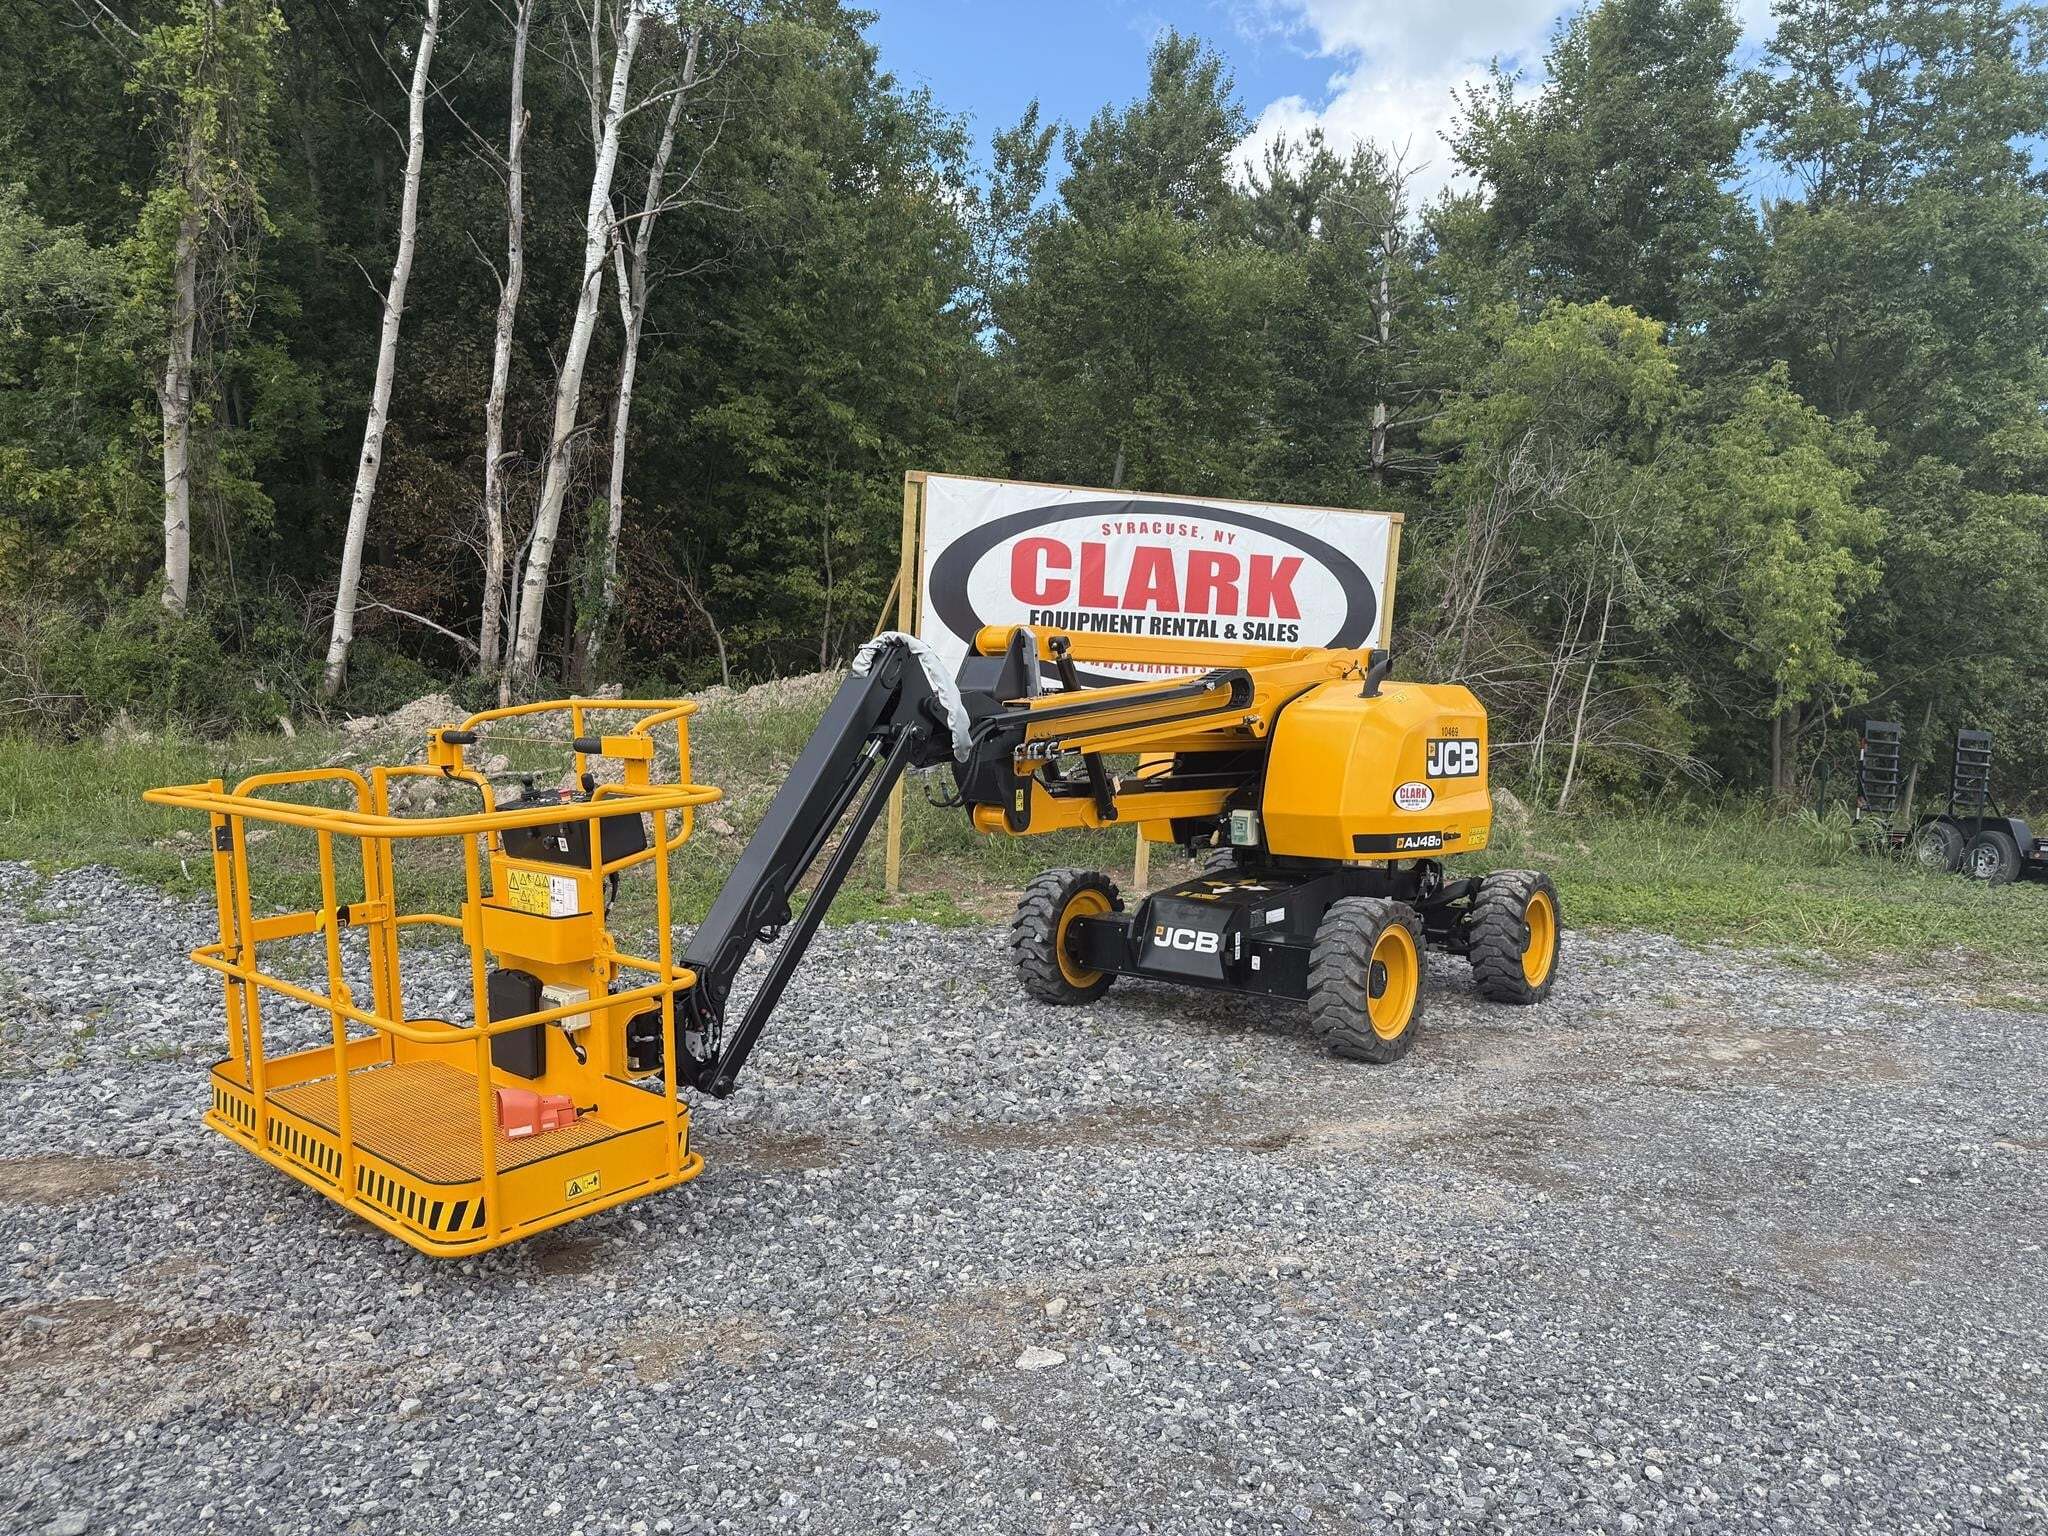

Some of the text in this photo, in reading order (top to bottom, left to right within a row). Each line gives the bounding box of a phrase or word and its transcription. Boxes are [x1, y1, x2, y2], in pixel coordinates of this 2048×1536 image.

[1102, 521, 1237, 545] SYRACUSE, NY
[1010, 537, 1304, 619] CLARK
[1029, 609, 1299, 643] EQUIPMENT RENTAL & SALES
[1428, 741, 1478, 776] JCB
[1399, 787, 1427, 799] CLARK
[1153, 928, 1219, 953] JCB
